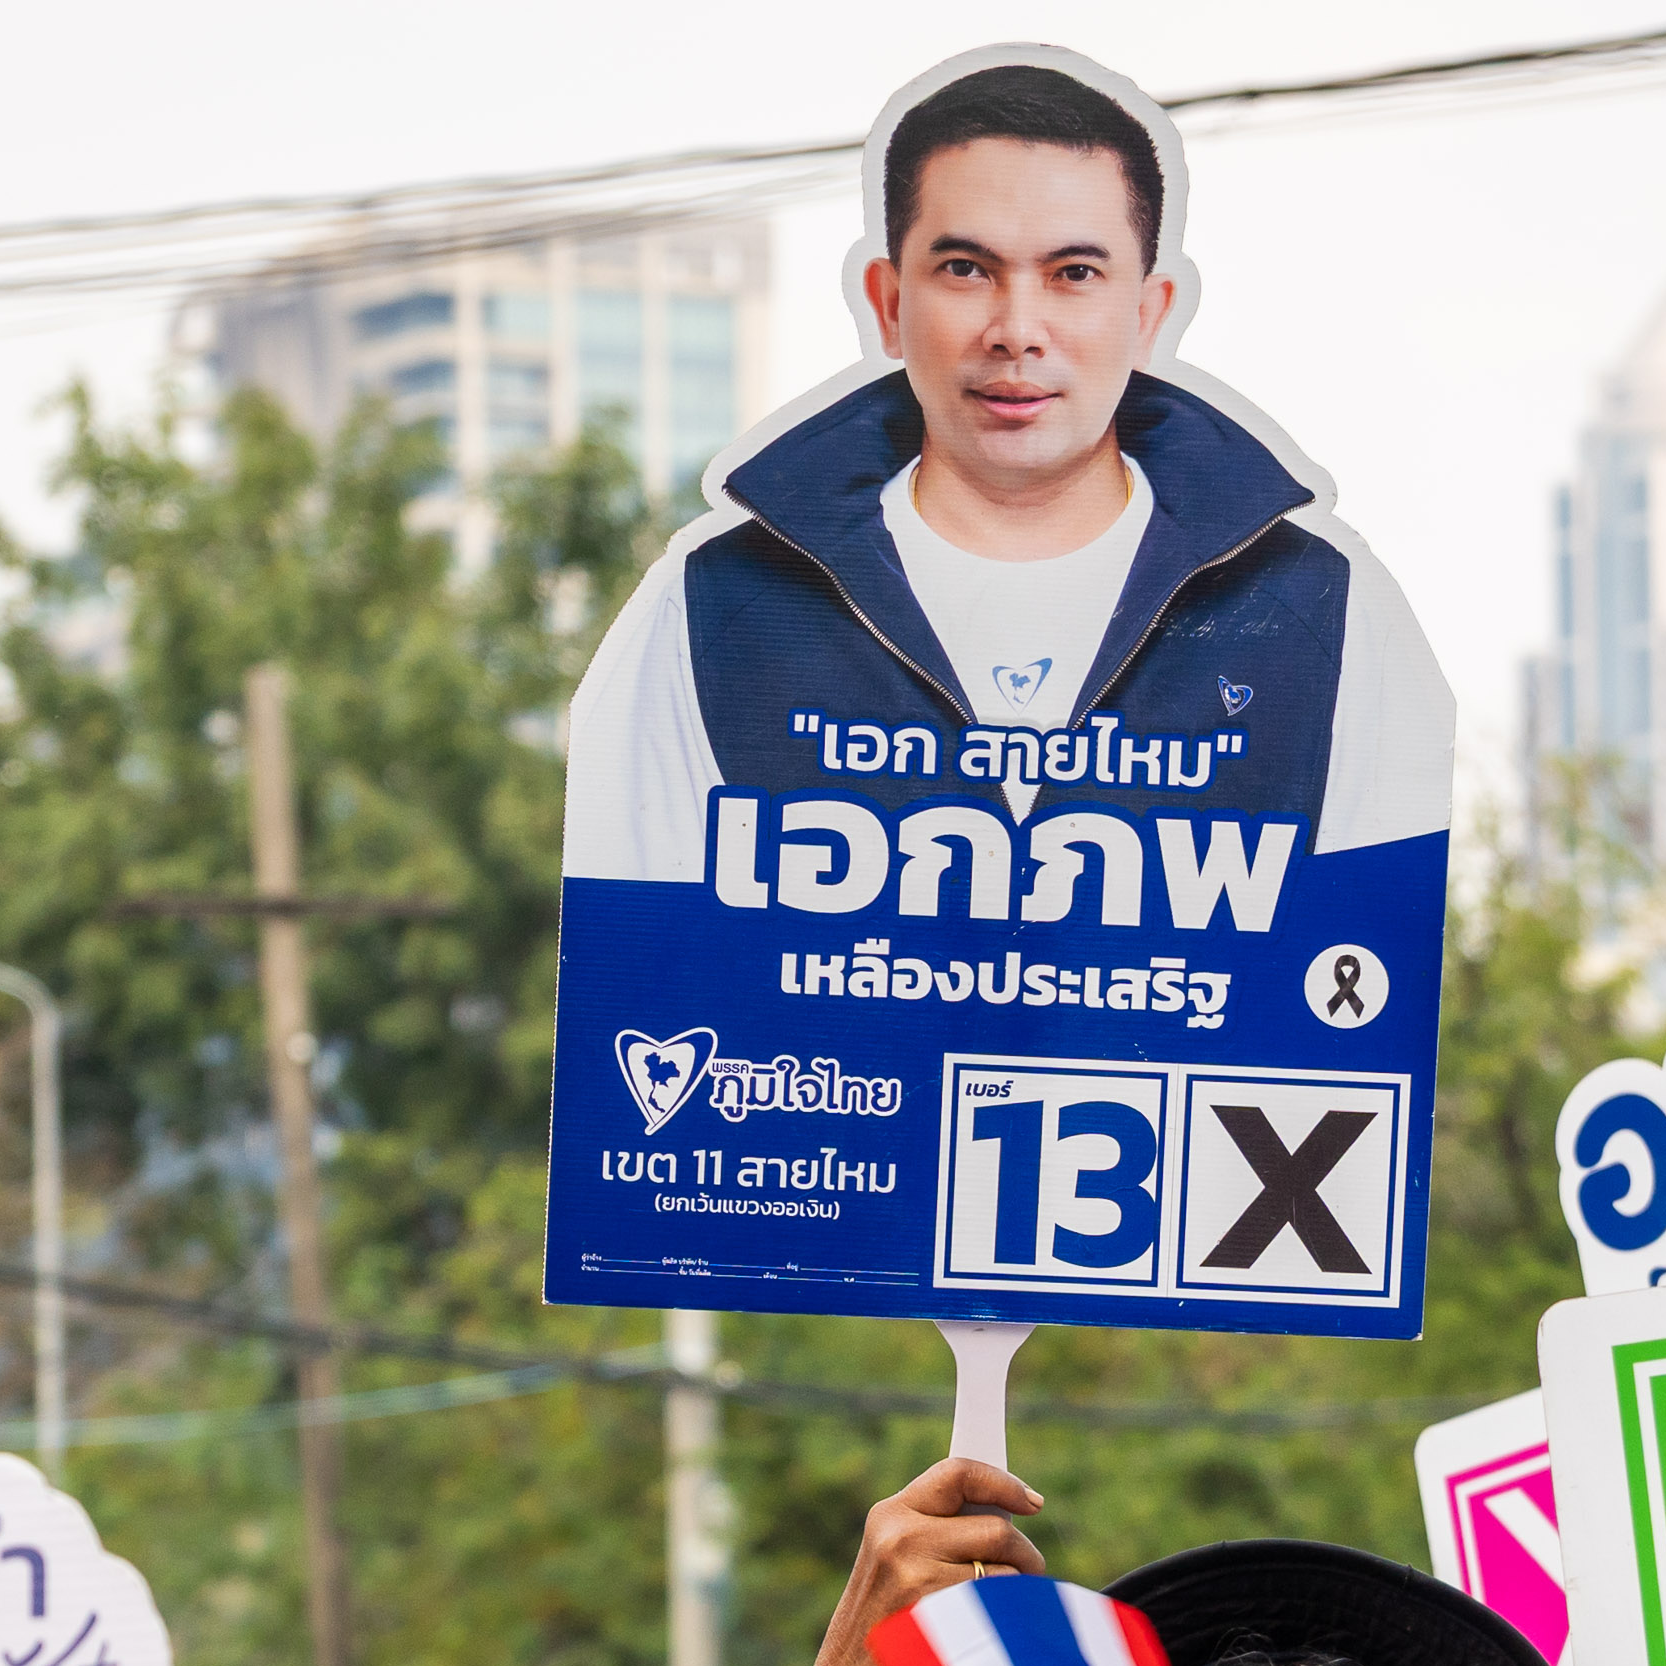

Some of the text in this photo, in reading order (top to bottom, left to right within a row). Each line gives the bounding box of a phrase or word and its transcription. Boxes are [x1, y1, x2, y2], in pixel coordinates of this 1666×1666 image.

[715, 796, 1298, 934] เอกภพ
[780, 937, 1233, 1030] เหลืองประเสริฐ
[712, 1060, 750, 1075] พรรค
[712, 1055, 901, 1121] ภูมิใจไทย
[964, 1079, 1014, 1099] เบอร์
[602, 1147, 896, 1194] เขต 11 สายไหม
[972, 1099, 1157, 1269] 13
[654, 1193, 841, 1220] (ยกเว้นแขวงออเงิน)
